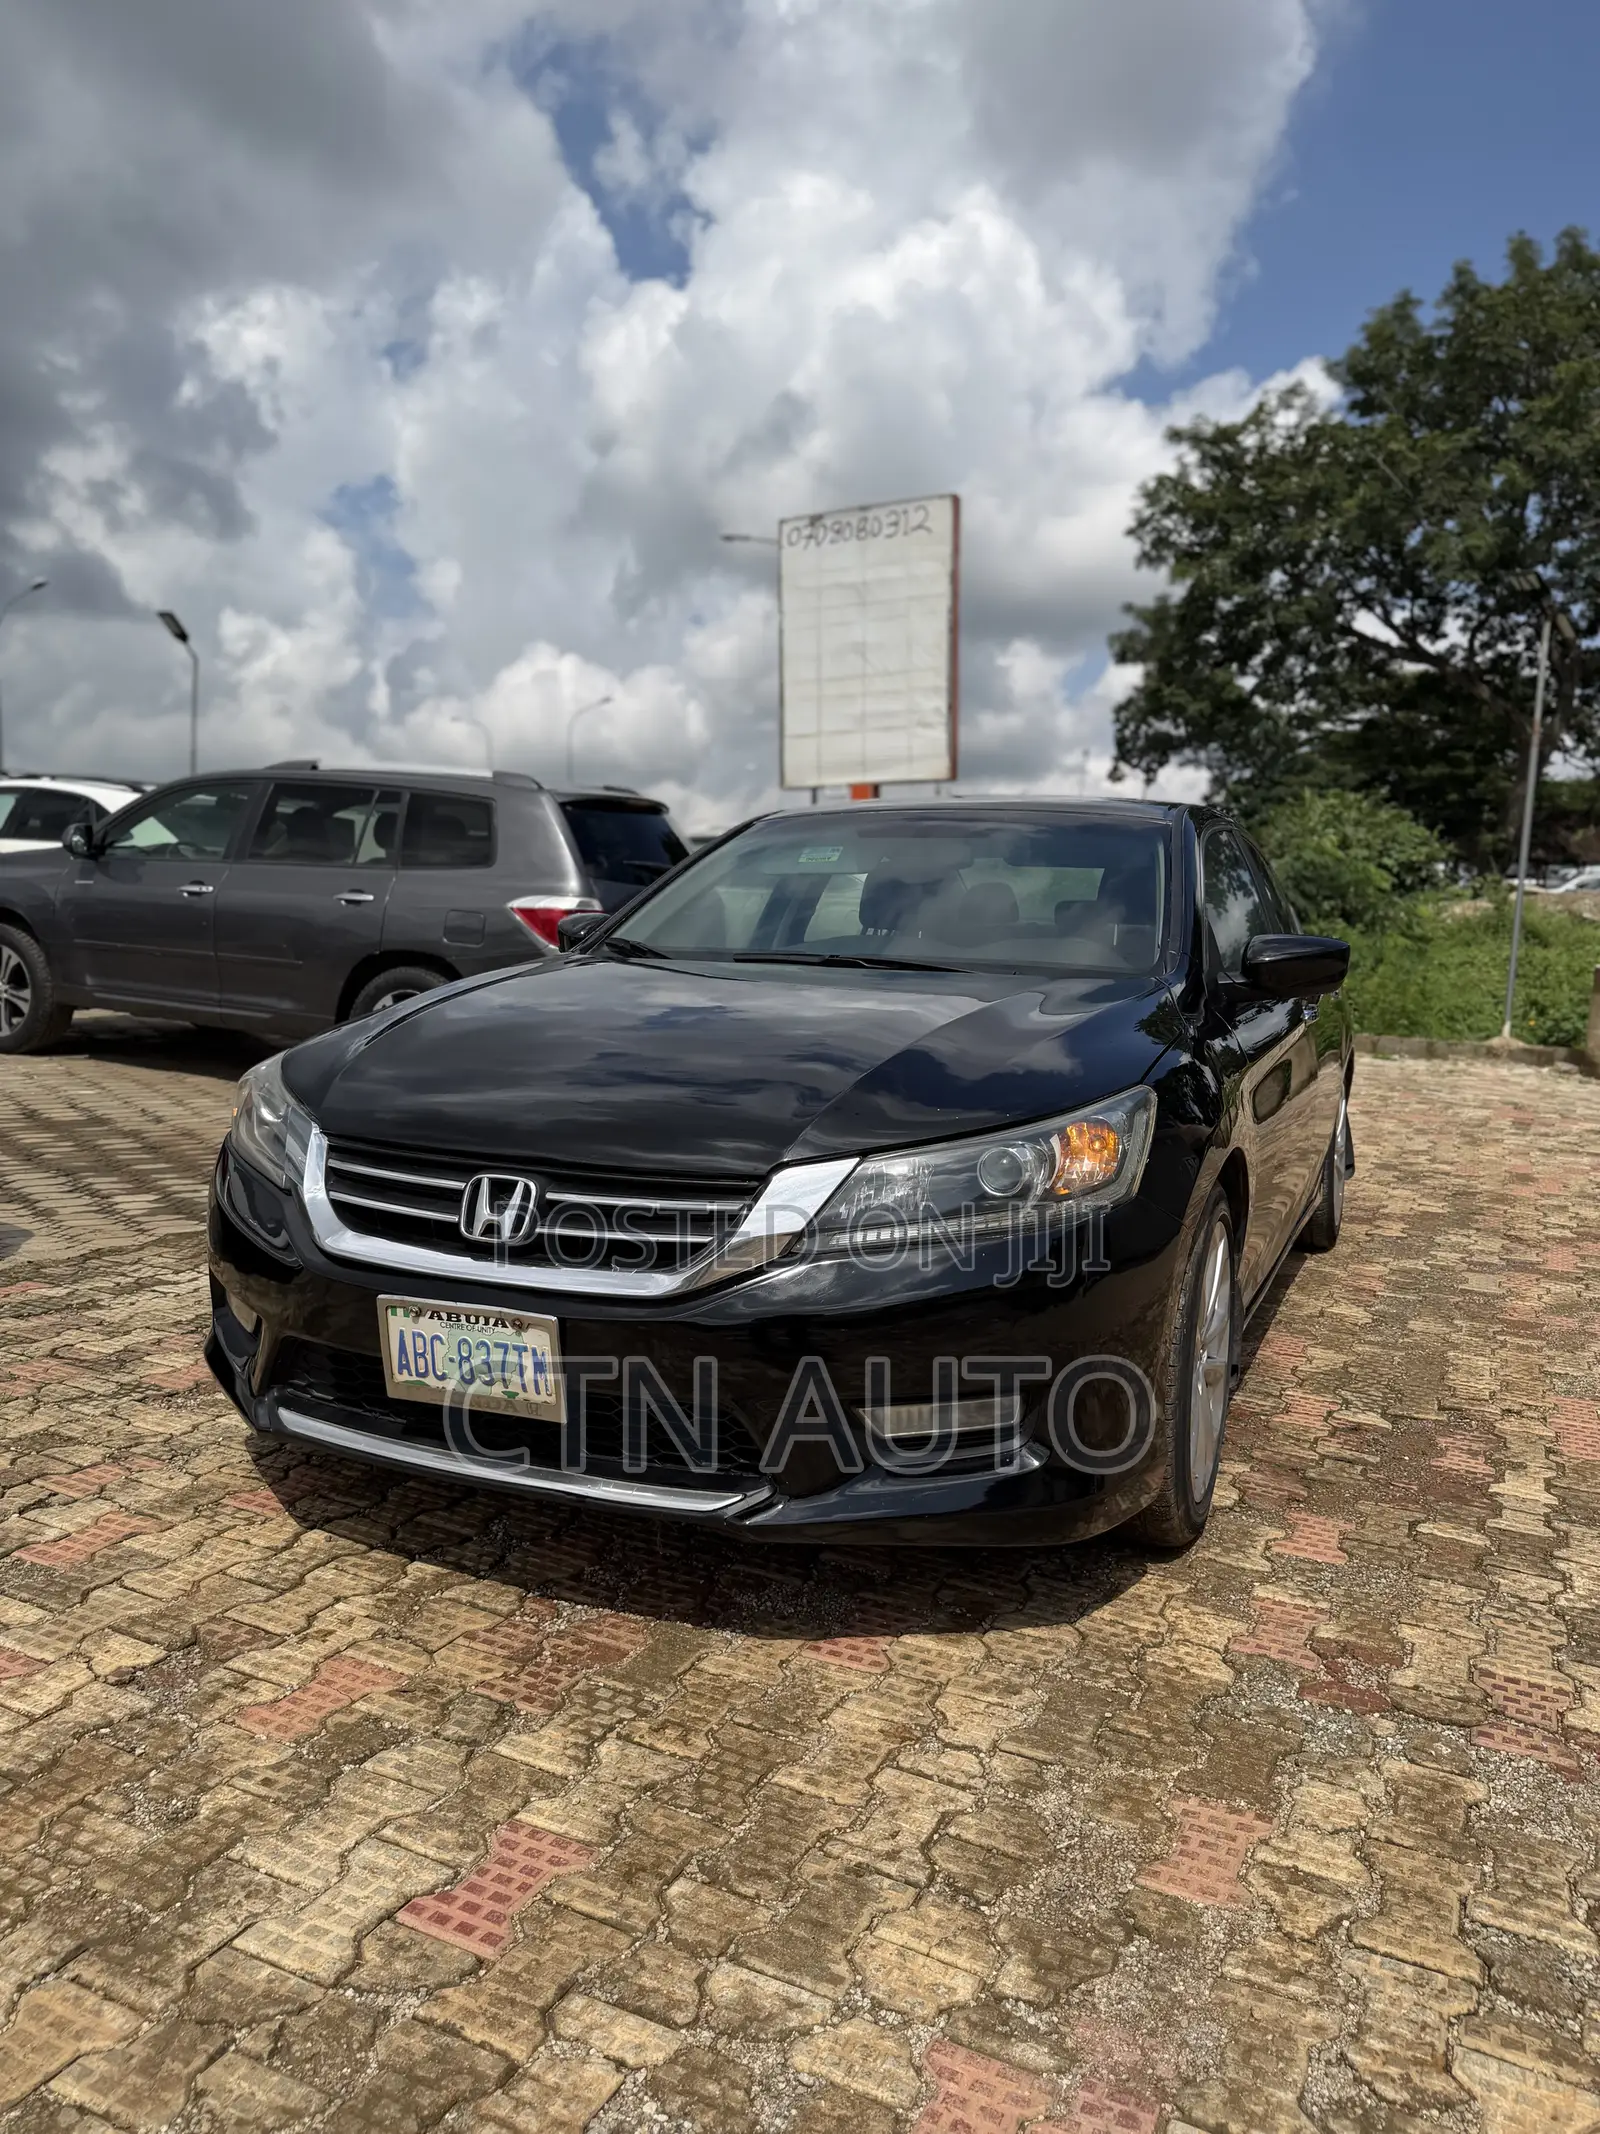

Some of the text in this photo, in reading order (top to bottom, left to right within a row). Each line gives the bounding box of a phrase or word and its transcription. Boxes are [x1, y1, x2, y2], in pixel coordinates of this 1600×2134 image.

[428, 1310, 509, 1329] ABUJA
[440, 1321, 465, 1331] CENTRE
[477, 1325, 496, 1334] UNITY
